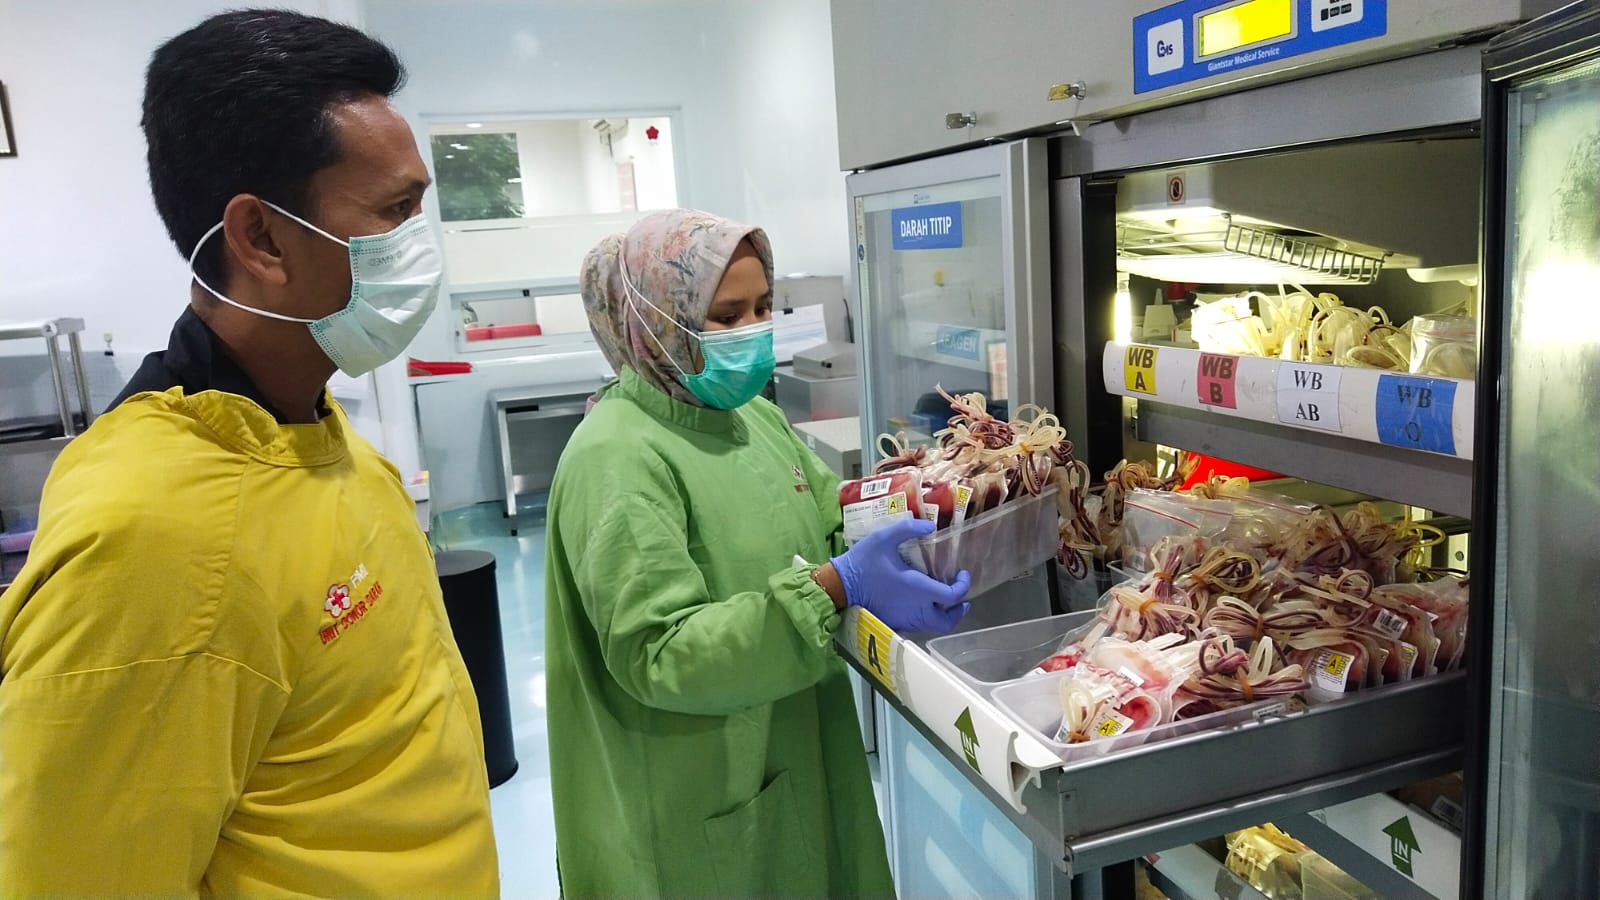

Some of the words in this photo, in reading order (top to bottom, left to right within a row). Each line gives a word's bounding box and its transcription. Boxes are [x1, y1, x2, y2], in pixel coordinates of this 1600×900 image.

[1208, 58, 1234, 71] Giantstar
[1234, 51, 1257, 65] Medical
[1258, 47, 1280, 59] Service
[900, 218, 928, 237] DARAH
[929, 216, 951, 235] TITIP
[1128, 347, 1154, 369] WB
[1202, 356, 1233, 379] WB
[1135, 371, 1147, 391] A
[1294, 370, 1322, 390] WB
[1210, 382, 1223, 404] B
[1397, 384, 1432, 409] WB
[1296, 403, 1320, 422] AB
[1405, 421, 1422, 442] O
[890, 501, 897, 509] A
[868, 633, 884, 676] A
[1328, 658, 1337, 670] A
[1100, 724, 1109, 733] A
[961, 731, 975, 757] IN
[1394, 838, 1409, 859] IN
